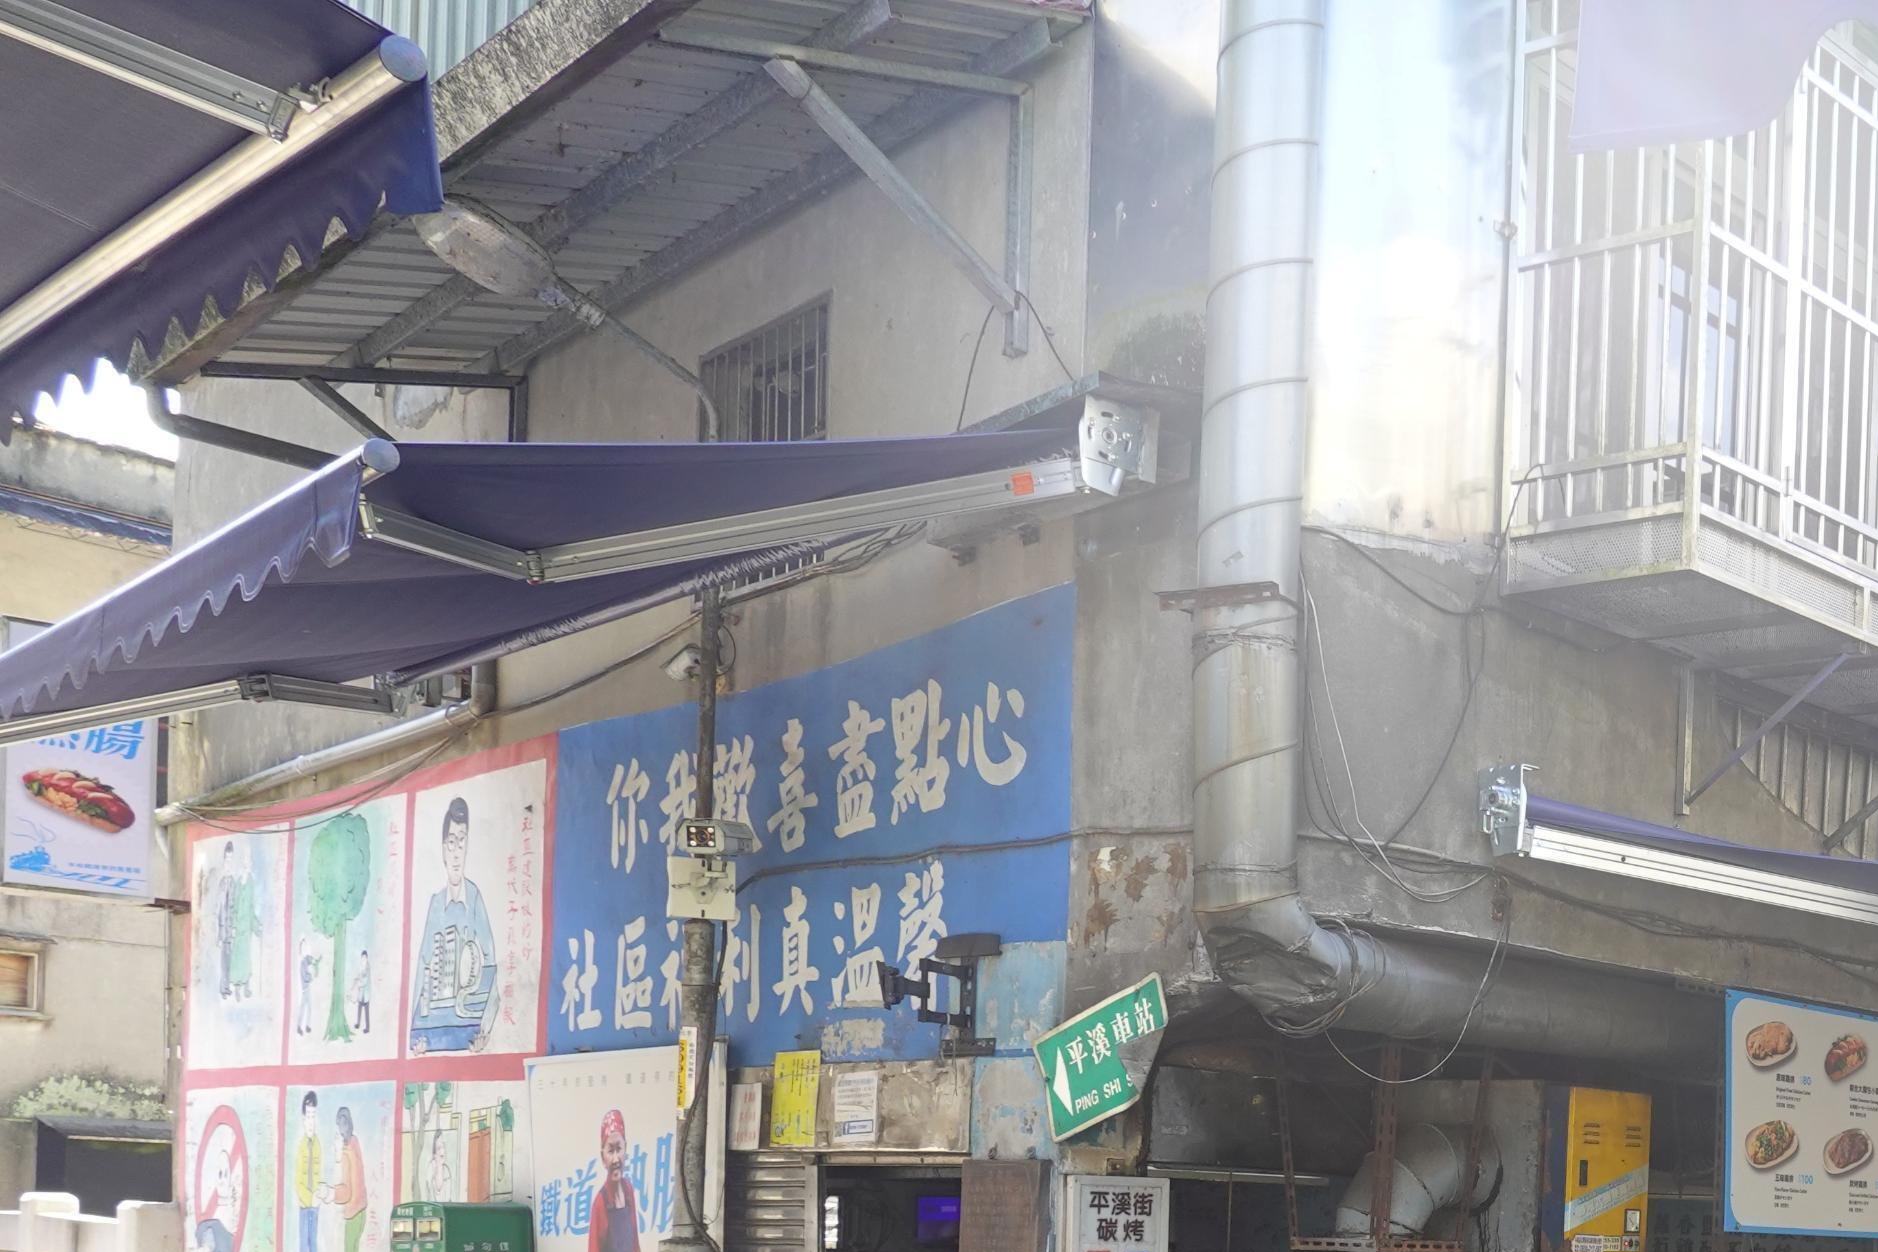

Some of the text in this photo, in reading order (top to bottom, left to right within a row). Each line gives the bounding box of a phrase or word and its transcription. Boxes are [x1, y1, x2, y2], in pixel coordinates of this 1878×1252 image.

[1065, 998, 1155, 1074] 平溪車站
[1075, 1090, 1099, 1114] PING
[1104, 1078, 1122, 1099] SHI
[539, 1158, 598, 1238] 鐵道
[1089, 1190, 1154, 1217] 平溪街
[1096, 1218, 1145, 1242] 碳烤
